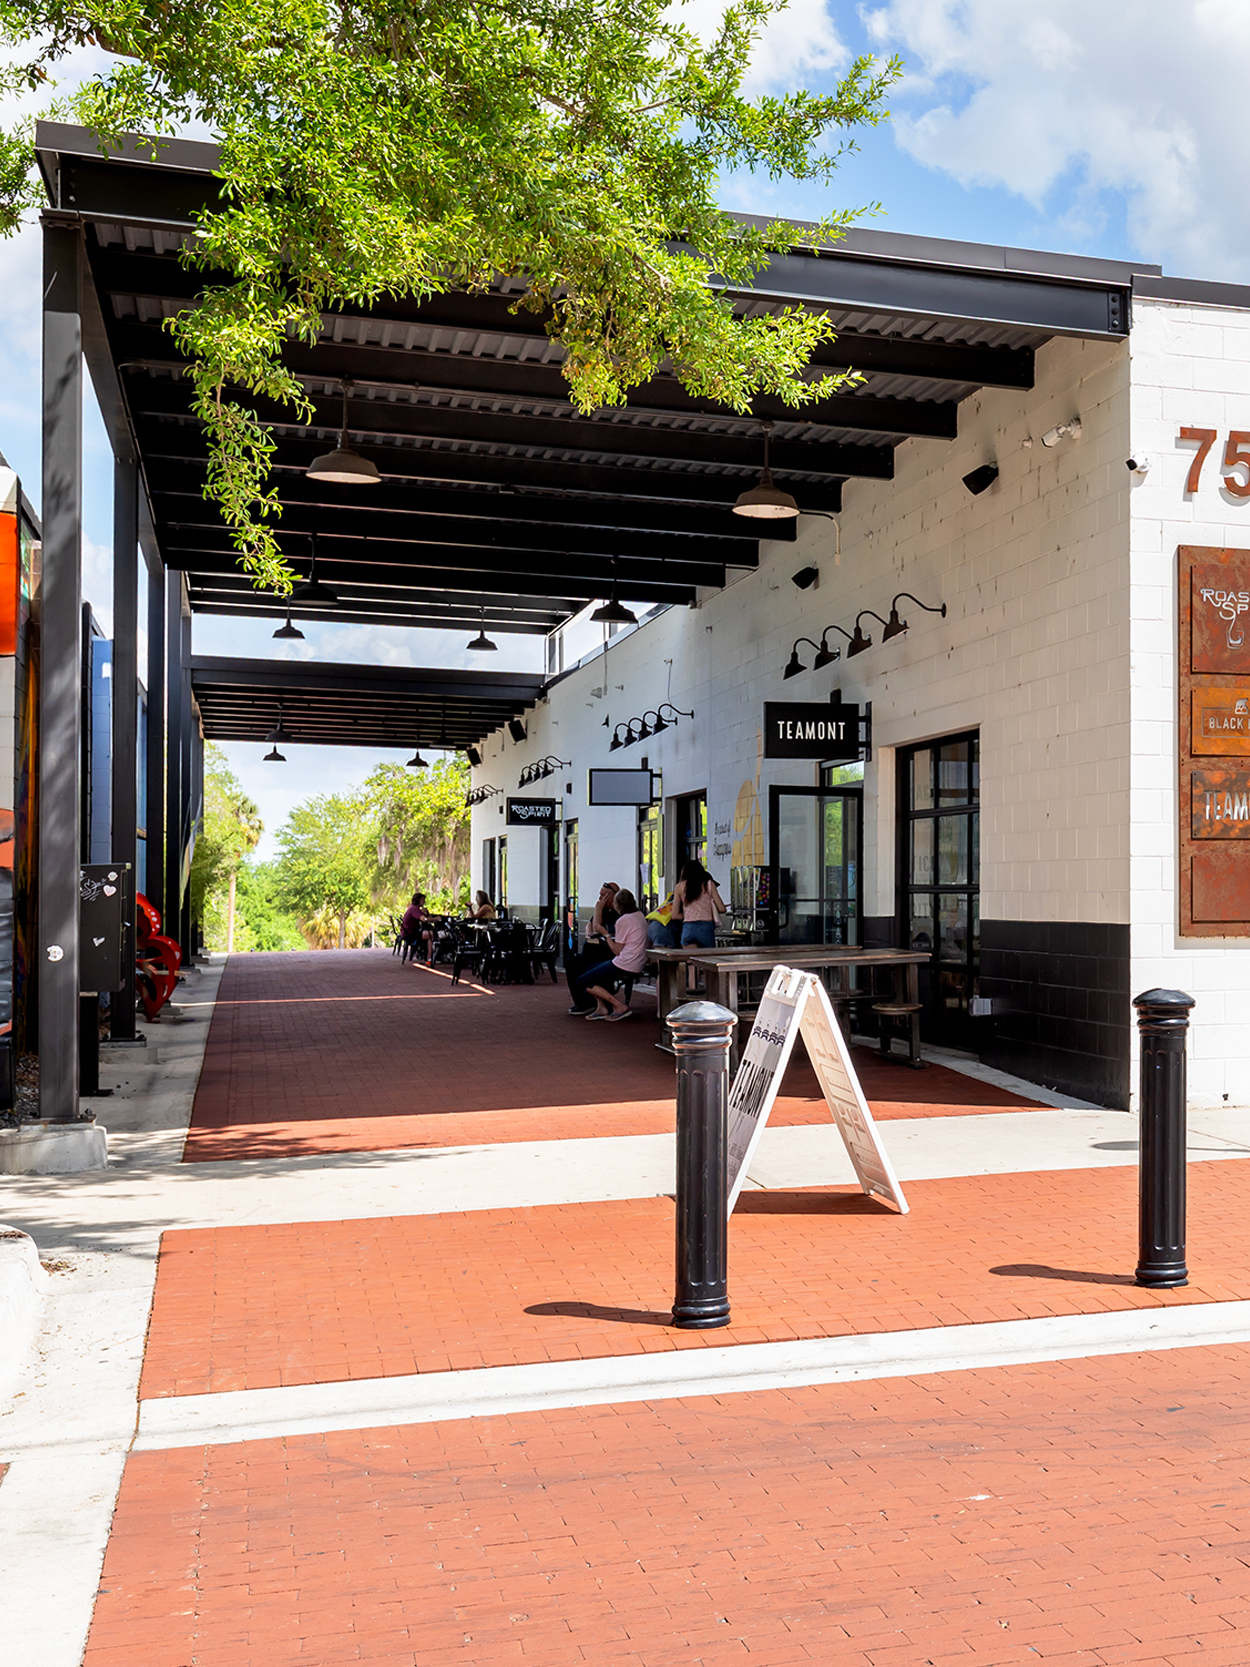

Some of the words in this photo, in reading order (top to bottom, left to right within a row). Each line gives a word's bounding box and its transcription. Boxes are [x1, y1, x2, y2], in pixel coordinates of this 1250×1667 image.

[776, 720, 846, 740] TEAMONT
[1208, 716, 1244, 730] BLACK
[510, 804, 552, 814] ROASTED
[519, 810, 551, 819] SPIRIT
[728, 1059, 776, 1120] TEAMONT
